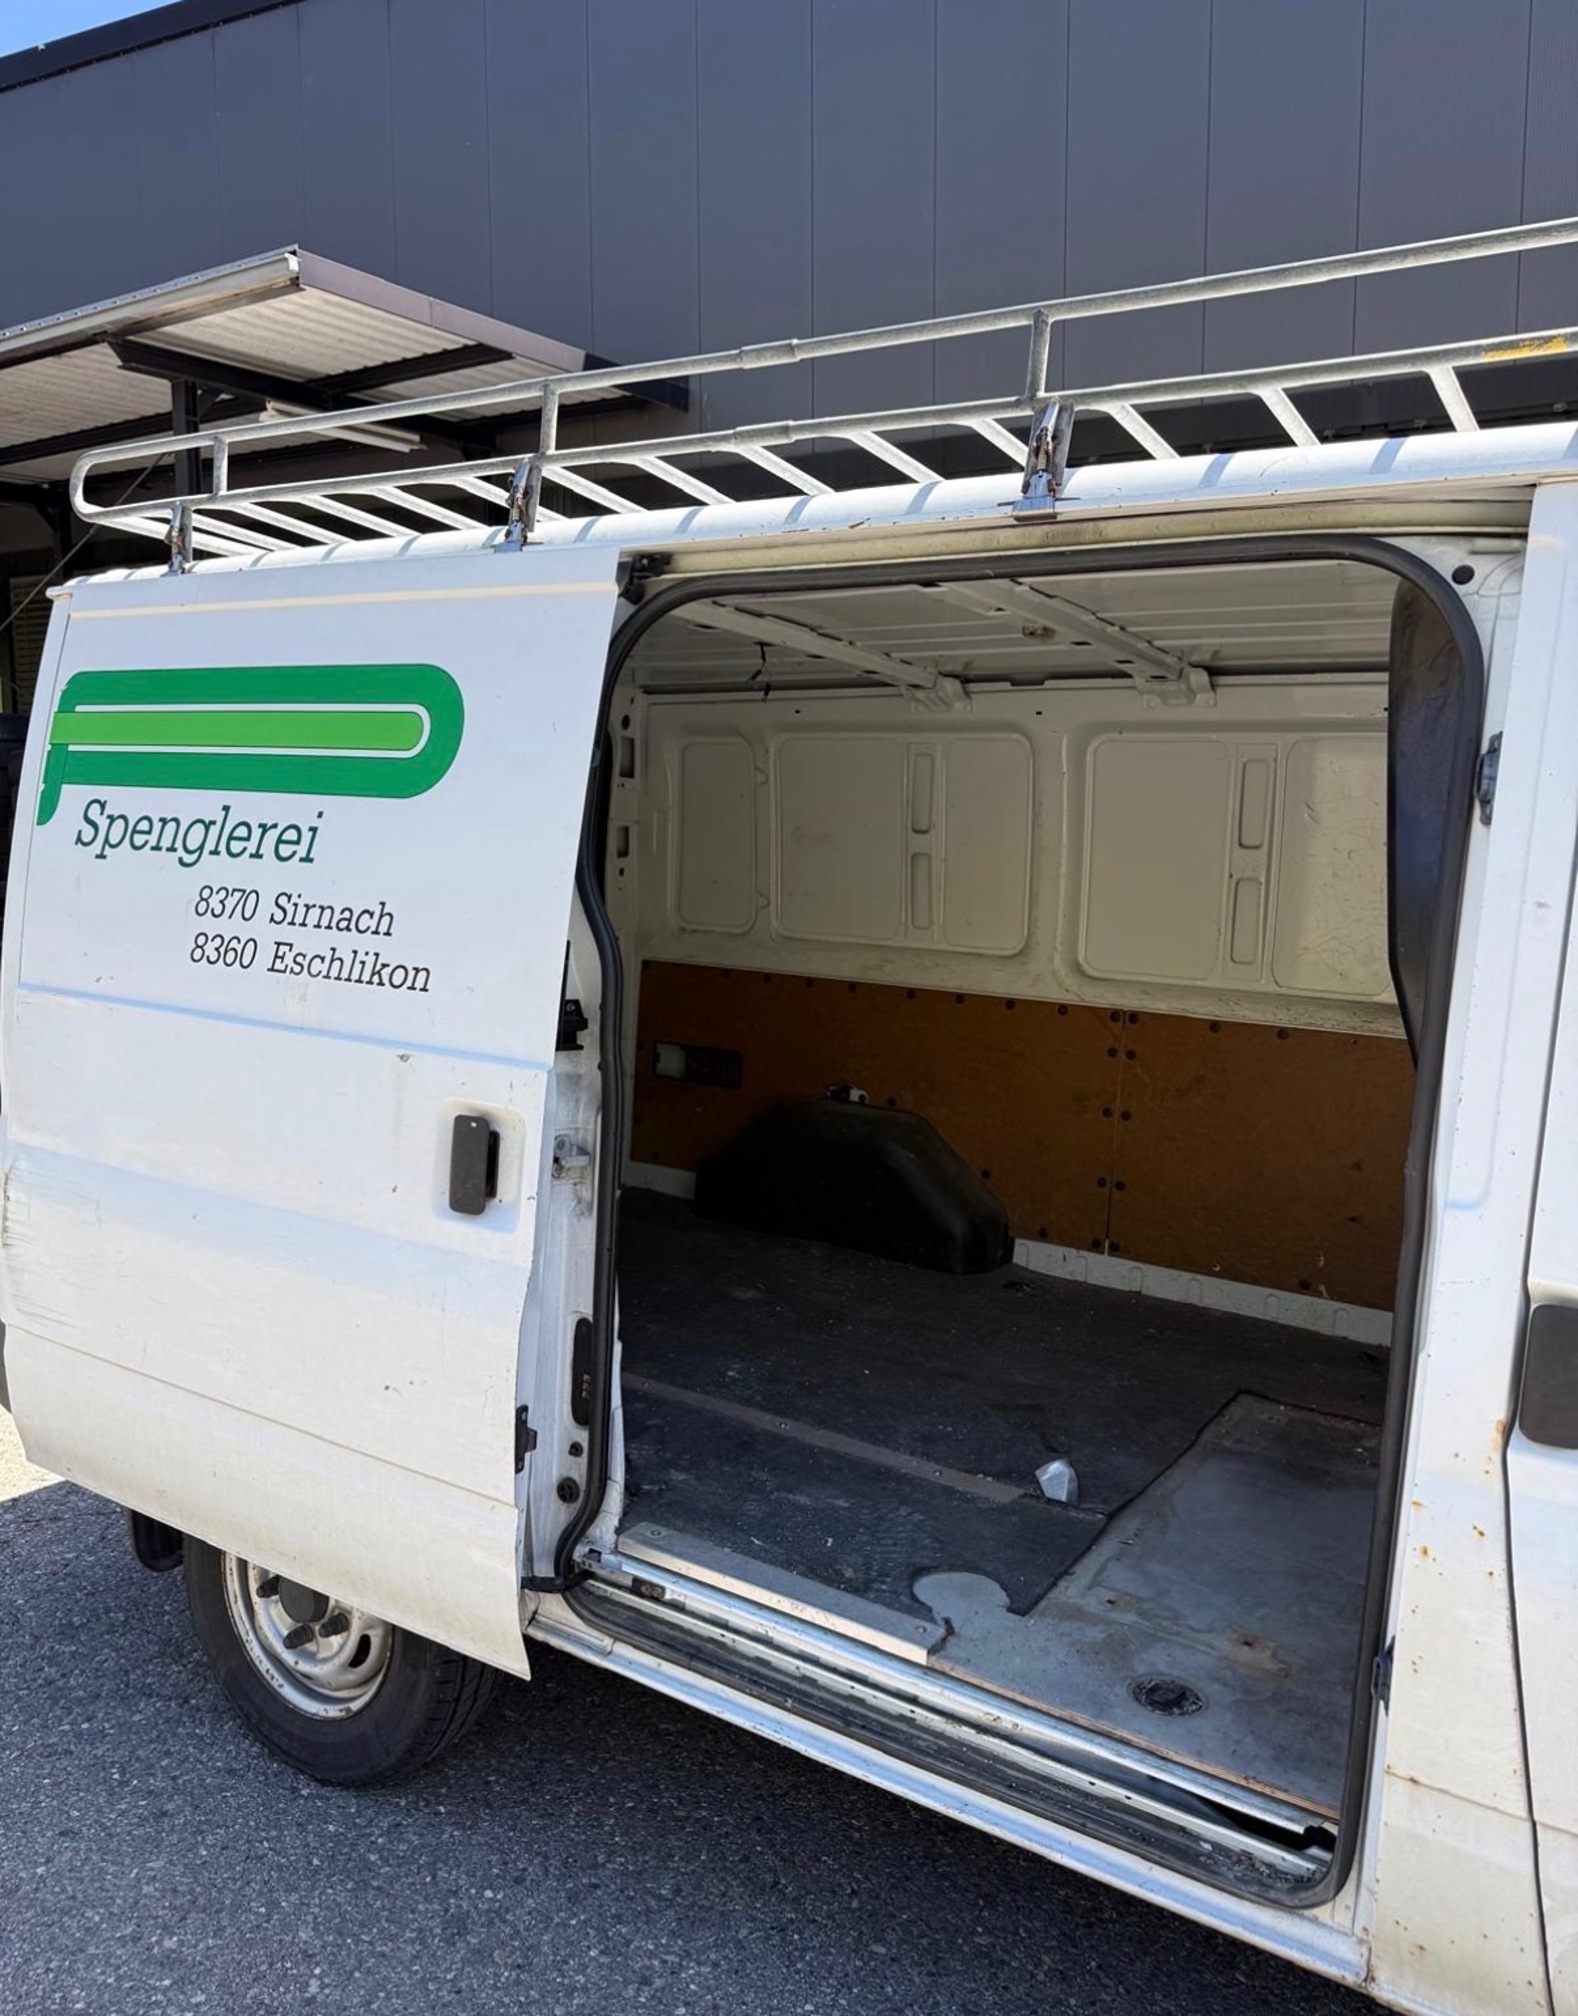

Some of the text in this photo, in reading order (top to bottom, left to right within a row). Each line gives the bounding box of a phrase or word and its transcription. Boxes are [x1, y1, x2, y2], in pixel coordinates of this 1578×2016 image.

[75, 798, 324, 868] Spenglerei
[194, 885, 396, 936] 8370 Sirnach
[190, 932, 432, 992] 8360 Eschlikon
